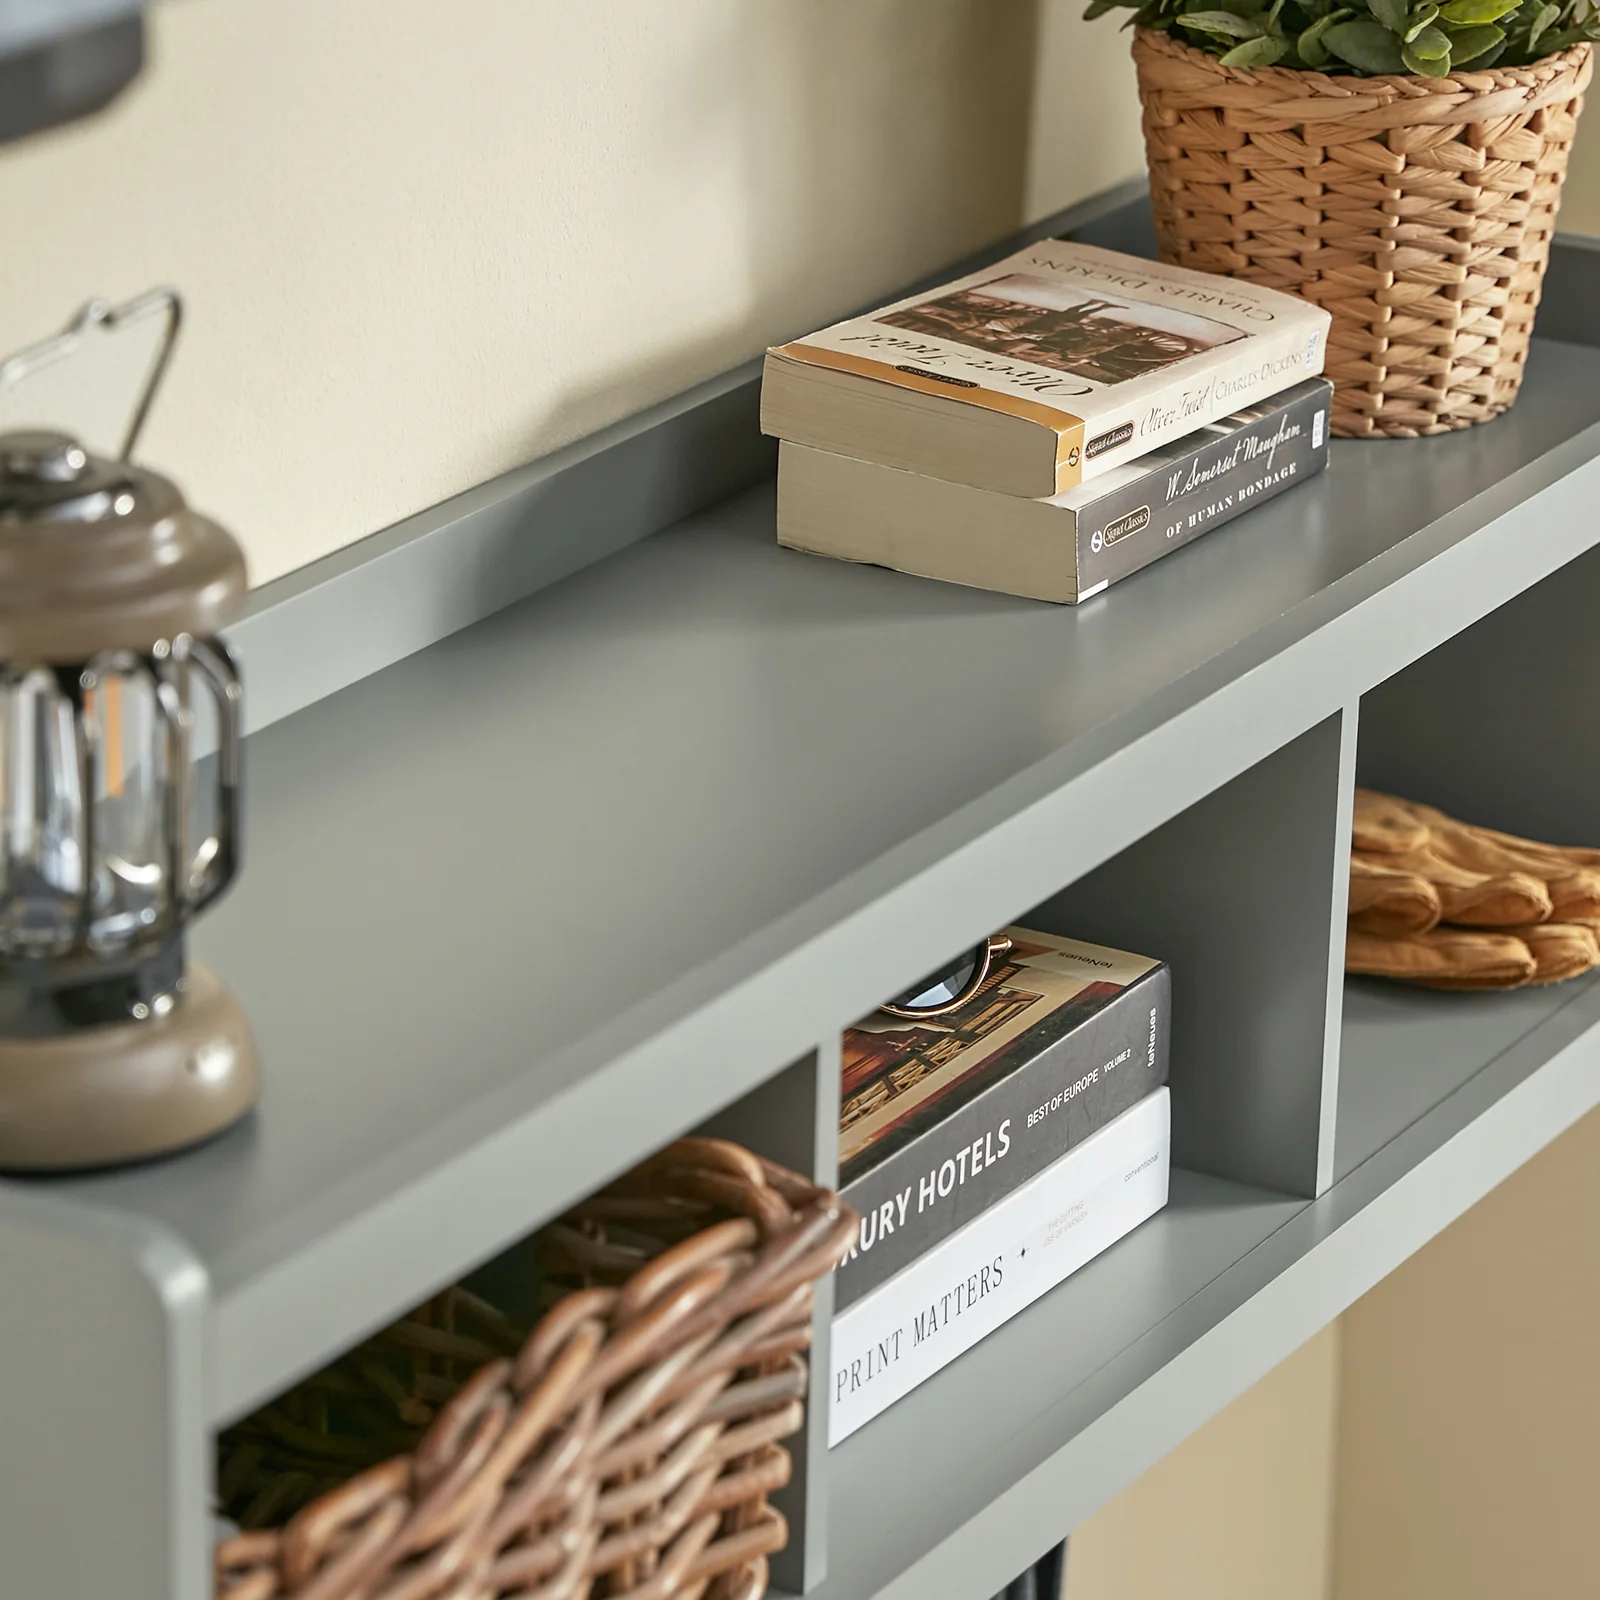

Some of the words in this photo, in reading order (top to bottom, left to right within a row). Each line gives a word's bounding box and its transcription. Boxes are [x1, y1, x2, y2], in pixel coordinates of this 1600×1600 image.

[1029, 257, 1148, 290] DICKENS
[1159, 287, 1275, 322] CHARLES
[965, 360, 1094, 396] Oliver
[1140, 401, 1176, 437] Oliver
[1177, 385, 1211, 420] Twist
[1215, 369, 1259, 401] CHARLES
[1260, 350, 1304, 382] DICKENS
[1165, 471, 1181, 501] W.
[1180, 439, 1242, 496] Somerset
[1243, 413, 1301, 470] Maugham
[1166, 521, 1184, 539] OF
[1188, 495, 1233, 528] HUMAN
[1238, 462, 1298, 502] BONDAGE
[1058, 950, 1114, 969] teNeues
[1147, 1007, 1157, 1068] teNeues
[1027, 1103, 1050, 1129] BEST
[1050, 1092, 1063, 1112] OF
[1063, 1068, 1100, 1103] EUROPE
[1103, 1051, 1127, 1073] VOLUME
[1126, 1048, 1132, 1058] 2
[1124, 1151, 1160, 1183] conventional
[831, 1186, 912, 1272] URY
[918, 1118, 1012, 1215] HOTELS
[1048, 1219, 1060, 1233] THE
[1060, 1200, 1085, 1225] CUTTING
[1043, 1234, 1056, 1248] USE
[1055, 1227, 1064, 1240] OF
[1063, 1209, 1089, 1233] VARNISH
[835, 1328, 904, 1404] PRINT
[912, 1255, 1004, 1348] MATTERS
